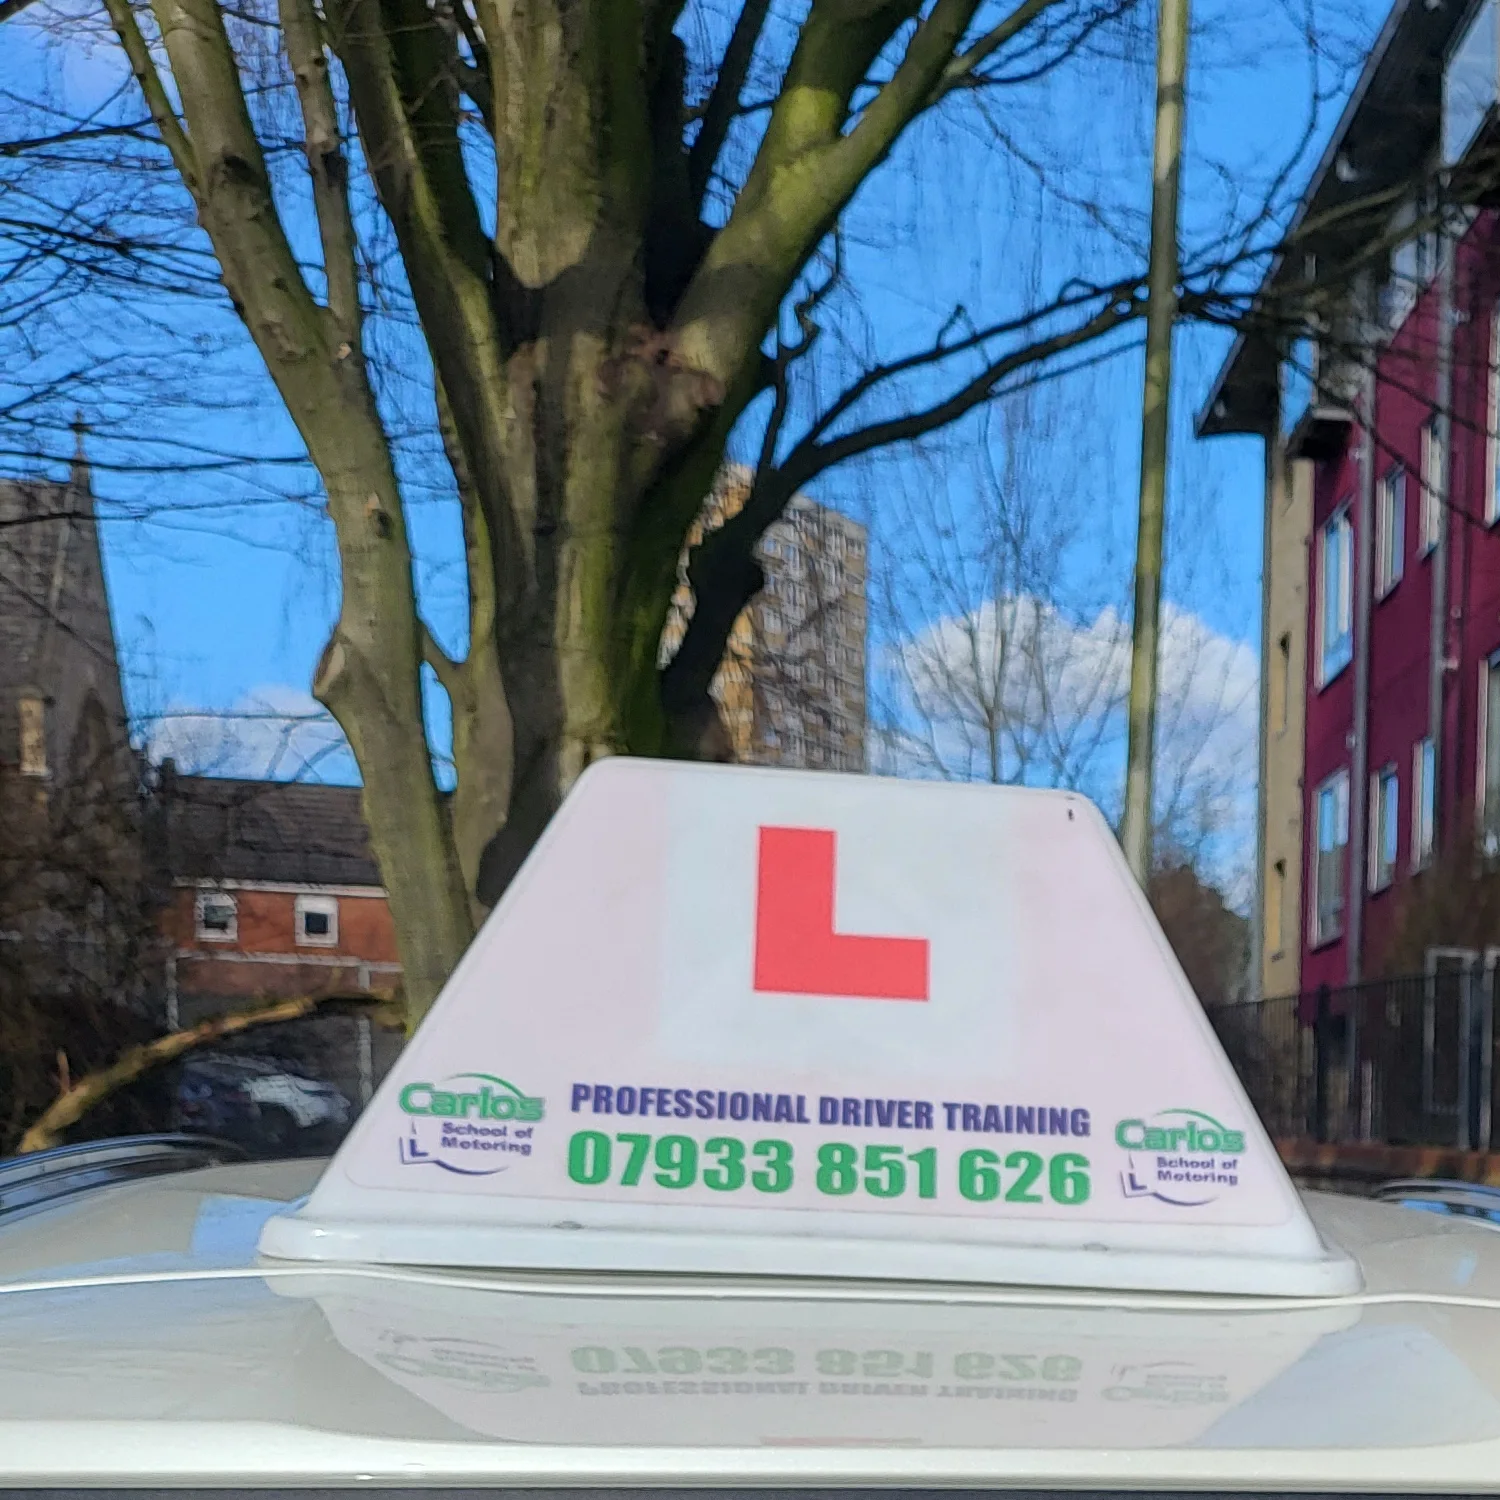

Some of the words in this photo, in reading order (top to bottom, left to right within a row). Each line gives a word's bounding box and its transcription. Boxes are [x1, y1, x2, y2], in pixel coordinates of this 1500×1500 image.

[753, 825, 930, 1002] L
[399, 1083, 546, 1122] Carlos
[570, 1083, 810, 1124] PROFESSIONAL
[818, 1095, 934, 1130] DRIVER
[942, 1102, 1091, 1137] TRAINING
[441, 1137, 532, 1156] Motoring
[442, 1122, 507, 1136] School
[515, 1127, 533, 1138] of
[1115, 1119, 1245, 1153] Carlos
[568, 1131, 793, 1193] 07933
[817, 1143, 938, 1199] 851
[958, 1149, 1092, 1205] 626
[1157, 1157, 1214, 1169] School
[1222, 1159, 1238, 1169] of
[1157, 1171, 1238, 1186] Motoring
